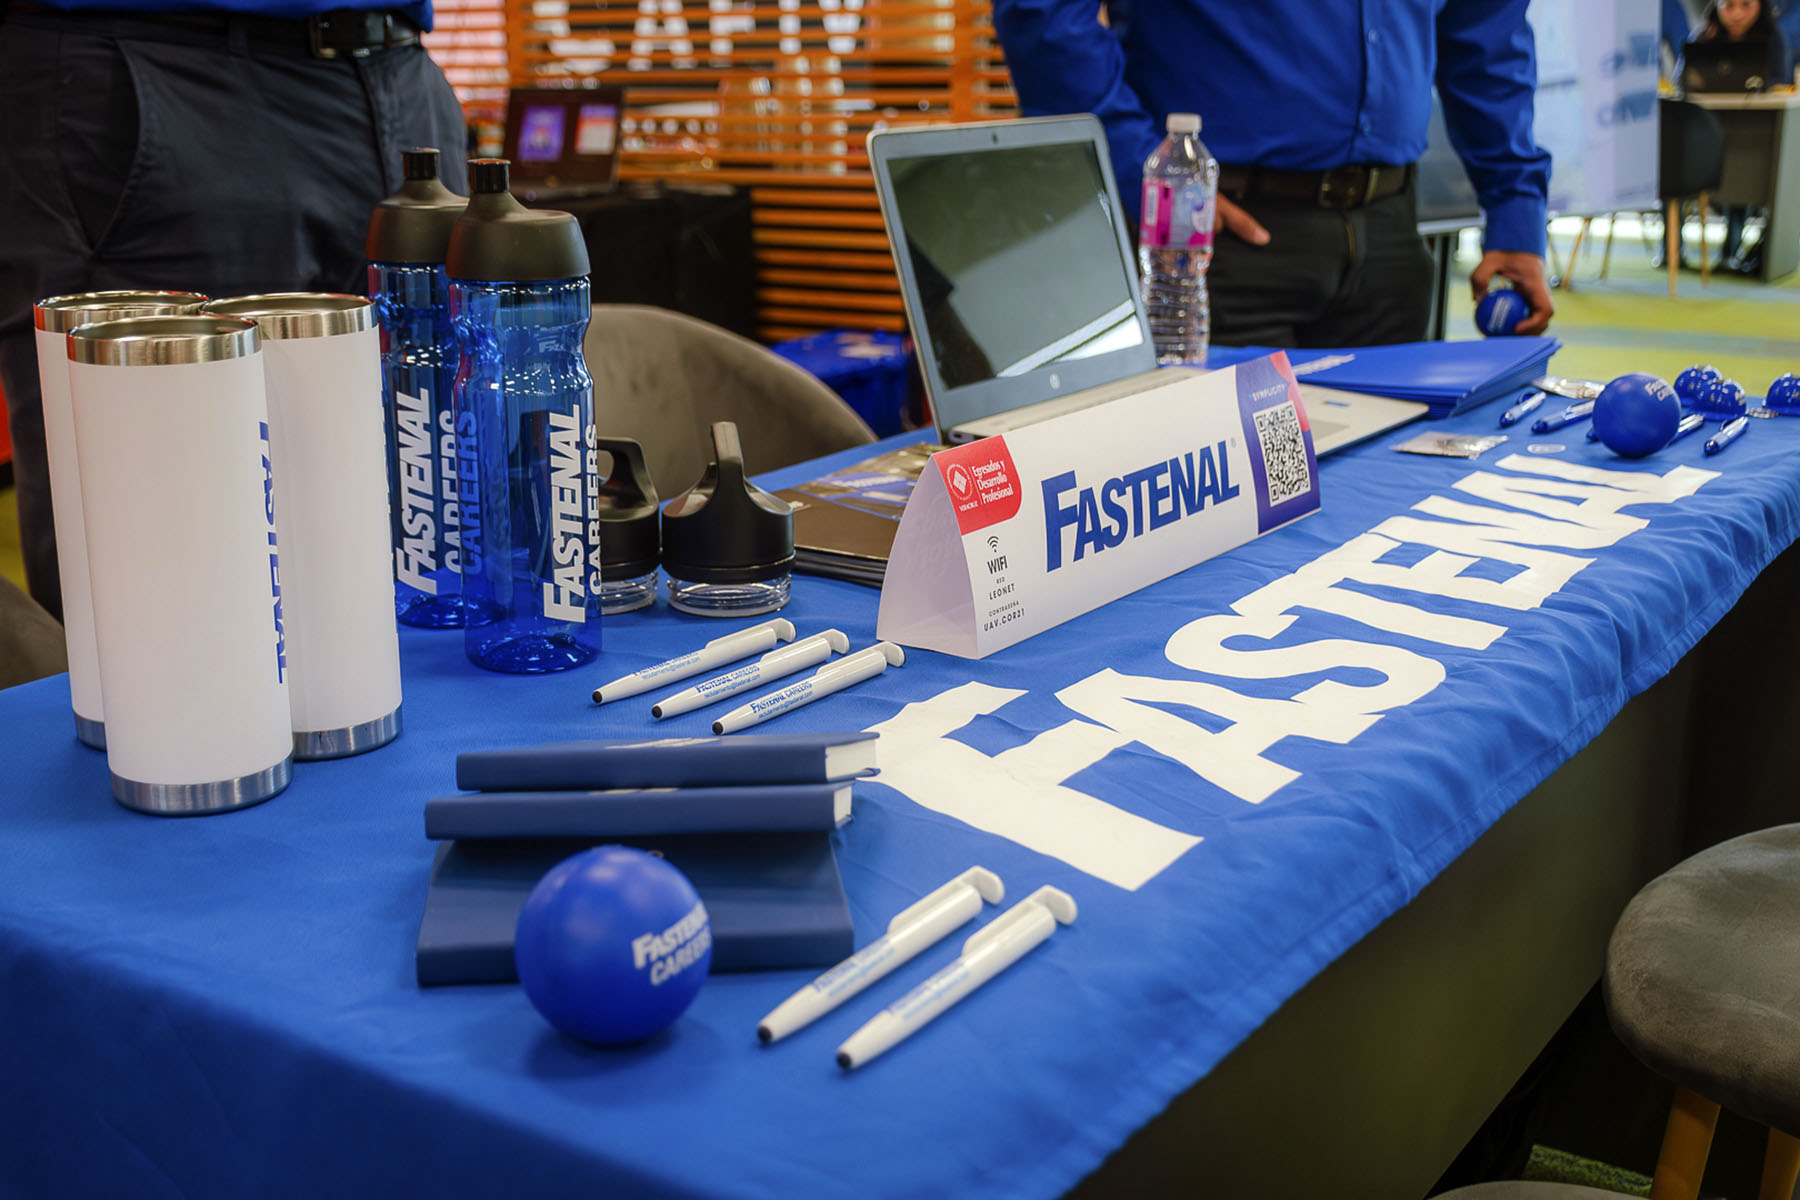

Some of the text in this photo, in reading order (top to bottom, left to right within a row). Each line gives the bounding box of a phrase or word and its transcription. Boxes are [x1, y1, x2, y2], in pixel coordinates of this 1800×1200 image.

[396, 388, 437, 595] FASTENAL
[439, 409, 484, 577] CAREERS
[972, 460, 1006, 480] Egresados y
[977, 472, 1008, 491] Desarrollo
[981, 483, 1014, 504] Profesional
[1041, 440, 1240, 573] FASTENAL
[543, 404, 586, 624] FASTENAL
[584, 423, 602, 596] CAREERS
[987, 555, 1008, 574] WIFI
[989, 583, 1015, 600] LEONET
[983, 608, 1025, 632] UAV.COR21
[866, 454, 1723, 891] FASTENAL
